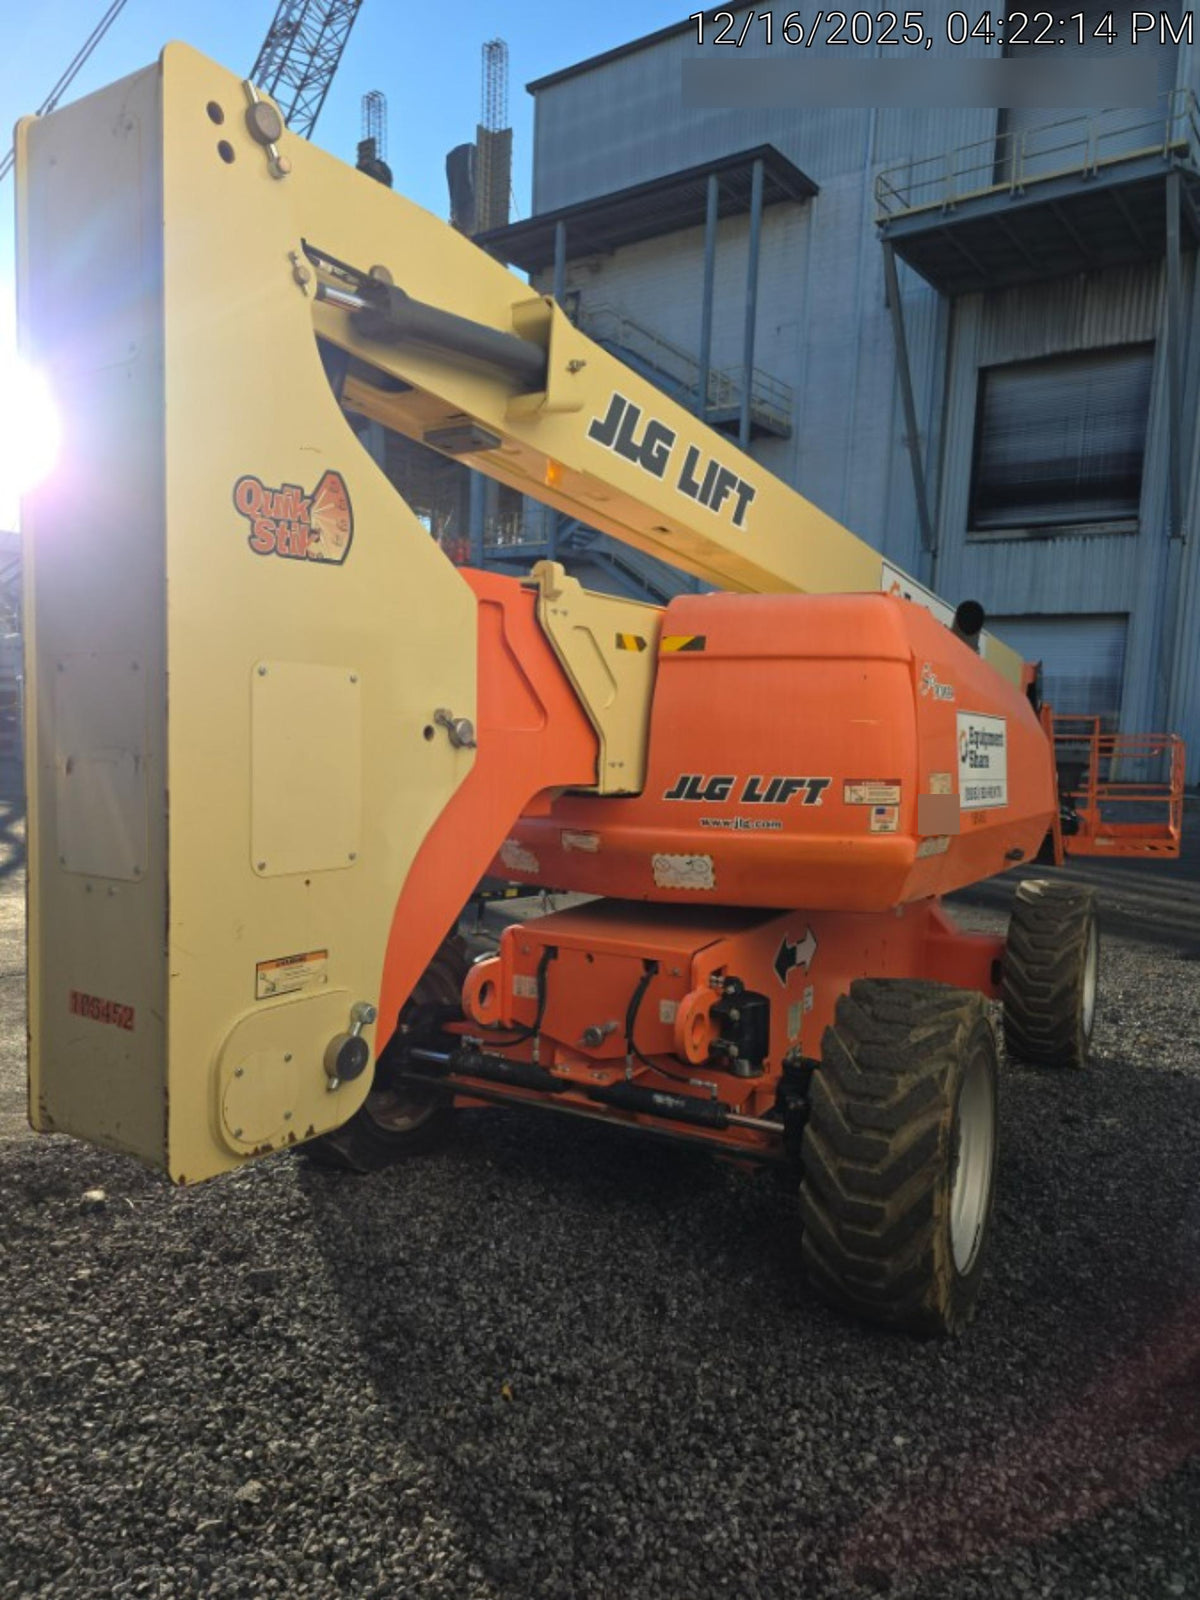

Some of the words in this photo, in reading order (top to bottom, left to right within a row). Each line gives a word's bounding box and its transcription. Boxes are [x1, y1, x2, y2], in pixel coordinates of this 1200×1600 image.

[587, 391, 677, 480] JLG
[676, 444, 757, 528] LIFT
[235, 479, 310, 524] Quik
[664, 776, 735, 800] JLG
[741, 777, 832, 804] LIFT
[700, 817, 783, 830] www.jlg.com
